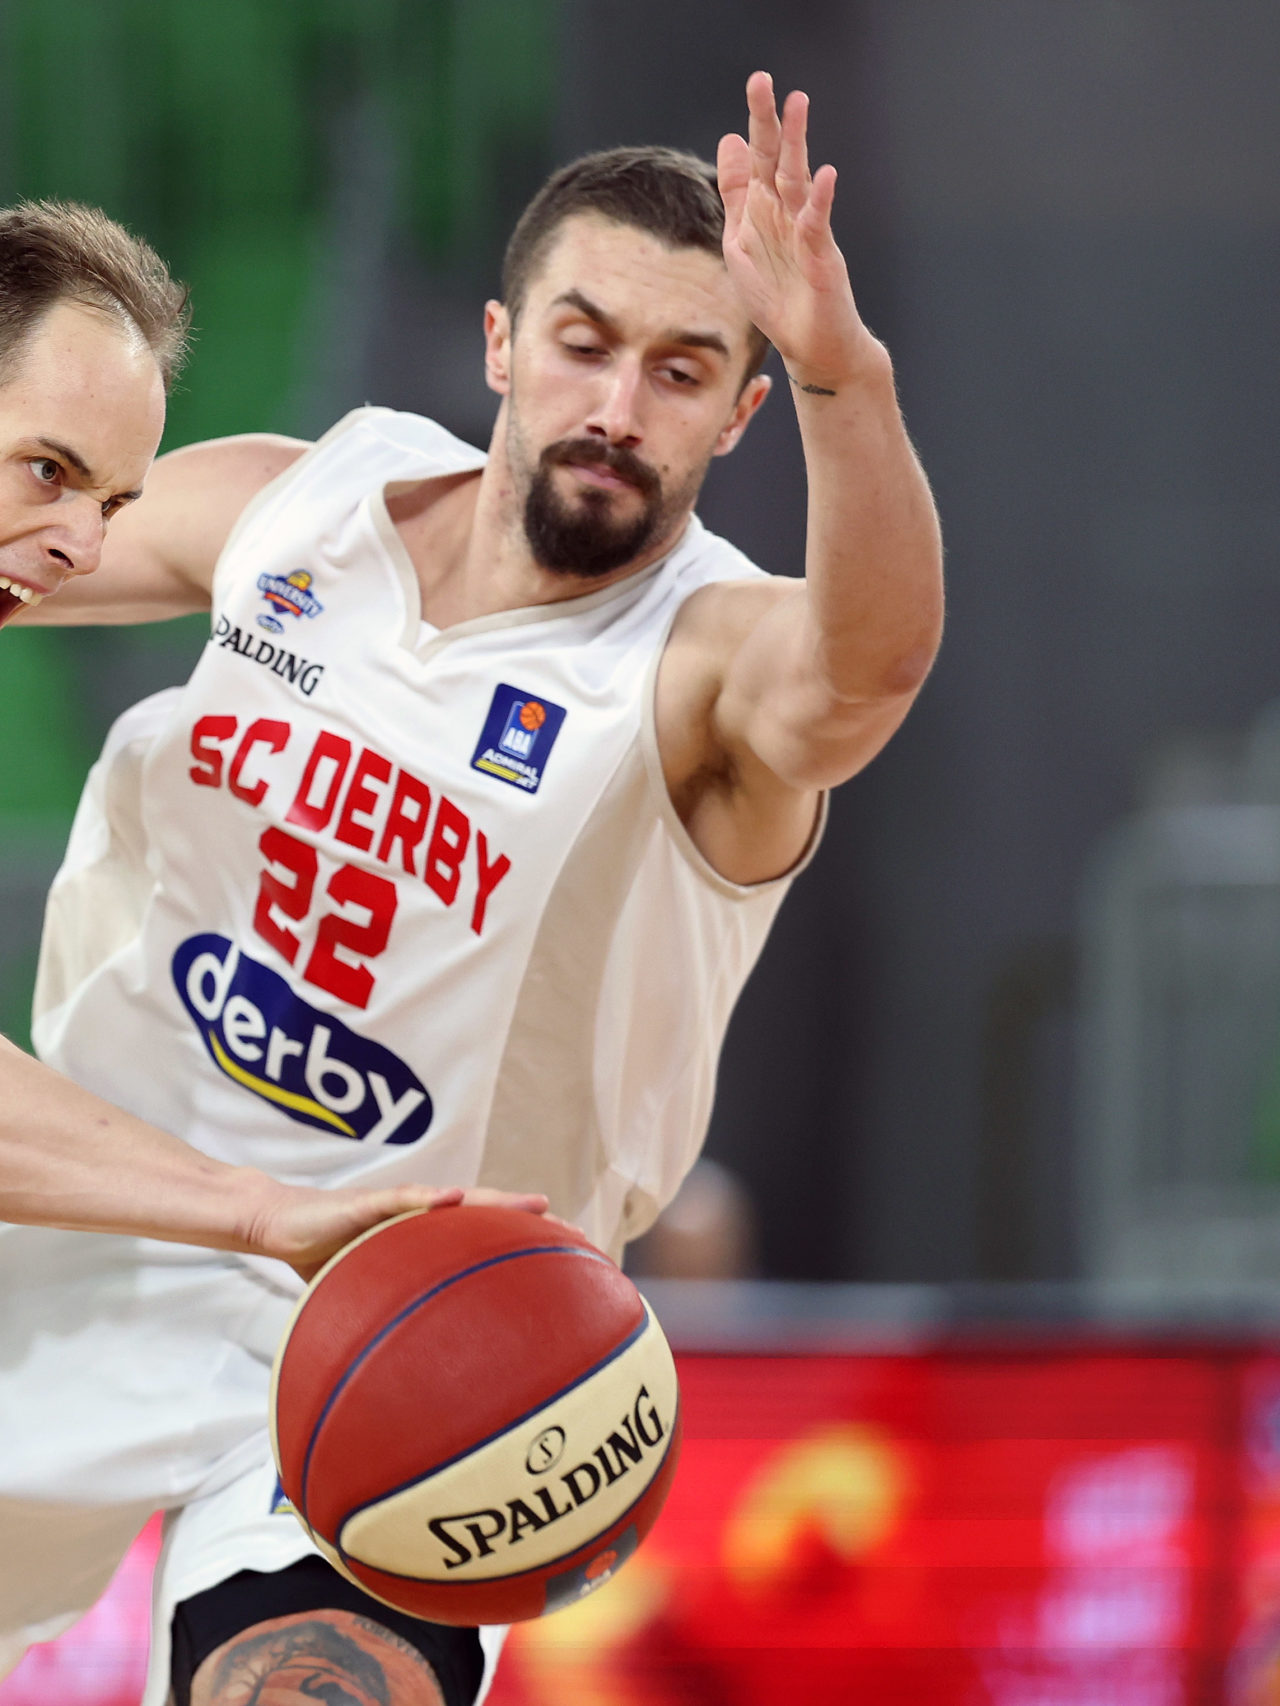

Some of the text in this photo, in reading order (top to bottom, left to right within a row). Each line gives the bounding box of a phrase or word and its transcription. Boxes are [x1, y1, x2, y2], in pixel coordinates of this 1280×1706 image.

[189, 715, 511, 936] SC DERBY
[253, 826, 398, 1010] 22
[186, 940, 426, 1144] derby
[428, 1384, 665, 1570] SPALDING
